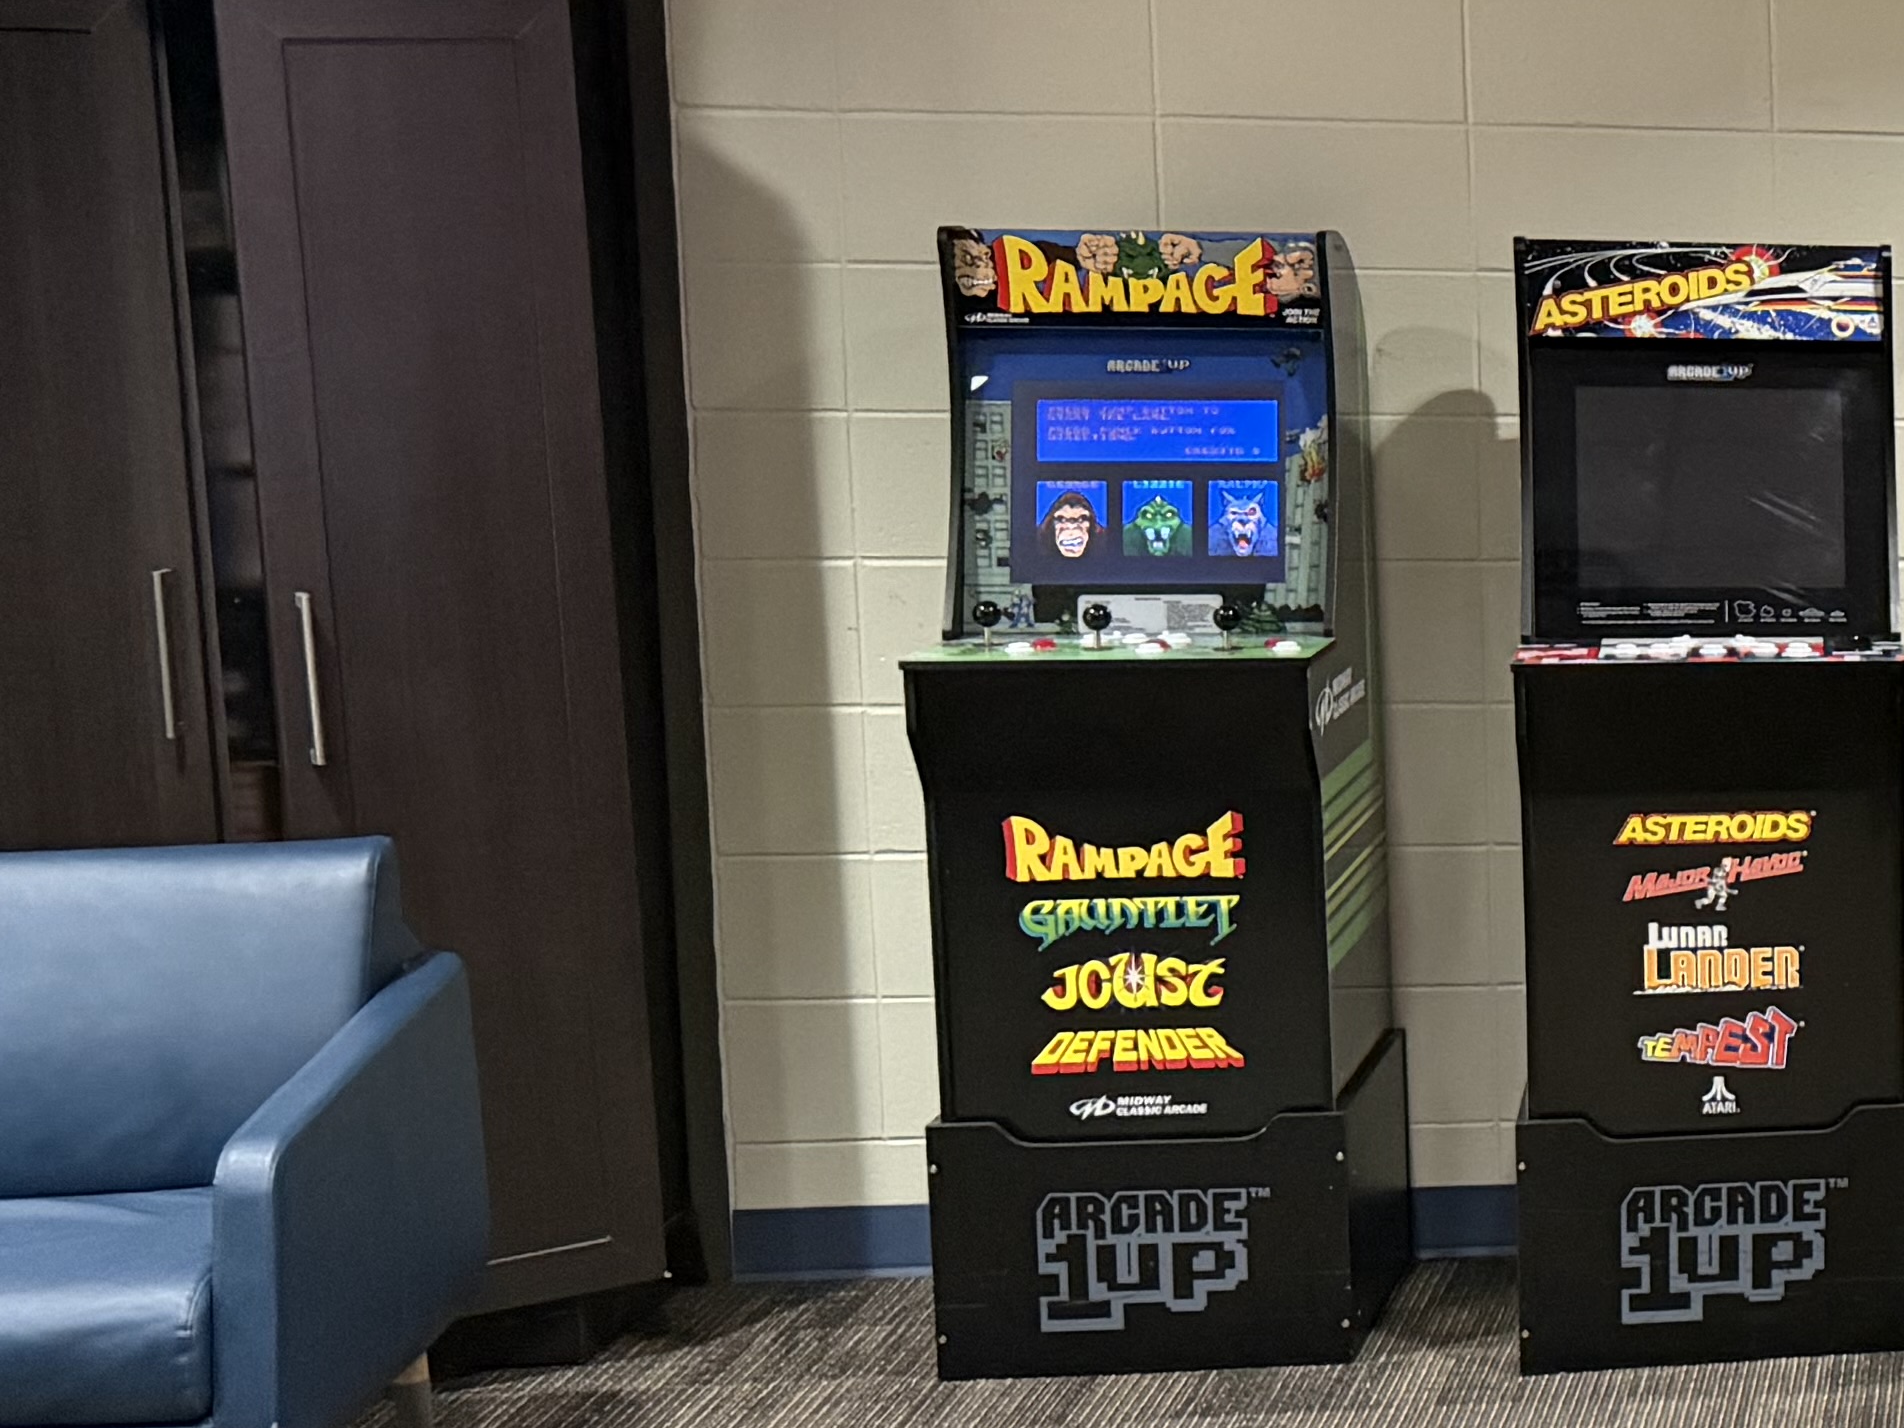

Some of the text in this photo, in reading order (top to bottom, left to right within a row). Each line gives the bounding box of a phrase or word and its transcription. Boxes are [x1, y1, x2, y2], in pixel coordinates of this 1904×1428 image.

[998, 235, 1277, 317] RAMPAGE
[1530, 260, 1758, 335] ASTEROIDS
[1106, 359, 1160, 372] ARCADE
[1002, 811, 1246, 882] RAMPAGE
[1613, 809, 1812, 845] ASTEROIDS
[1019, 894, 1240, 952] GAUNTLET
[1648, 922, 1728, 947] LUNAR
[1041, 952, 1227, 1010] JOUST
[1643, 946, 1801, 990] LANDER
[1031, 1027, 1245, 1075] DEFENDER
[1637, 1006, 1798, 1070] TEMPEST
[1116, 1095, 1172, 1106] MIDWAY
[1116, 1103, 1208, 1116] CLASSIC ARCADE
[1702, 1101, 1737, 1115] ATARI
[1036, 1188, 1248, 1239] ARCADE
[1620, 1178, 1826, 1232] ARCADE
[1038, 1233, 1248, 1332] 1UP
[1620, 1227, 1826, 1324] 1UP
